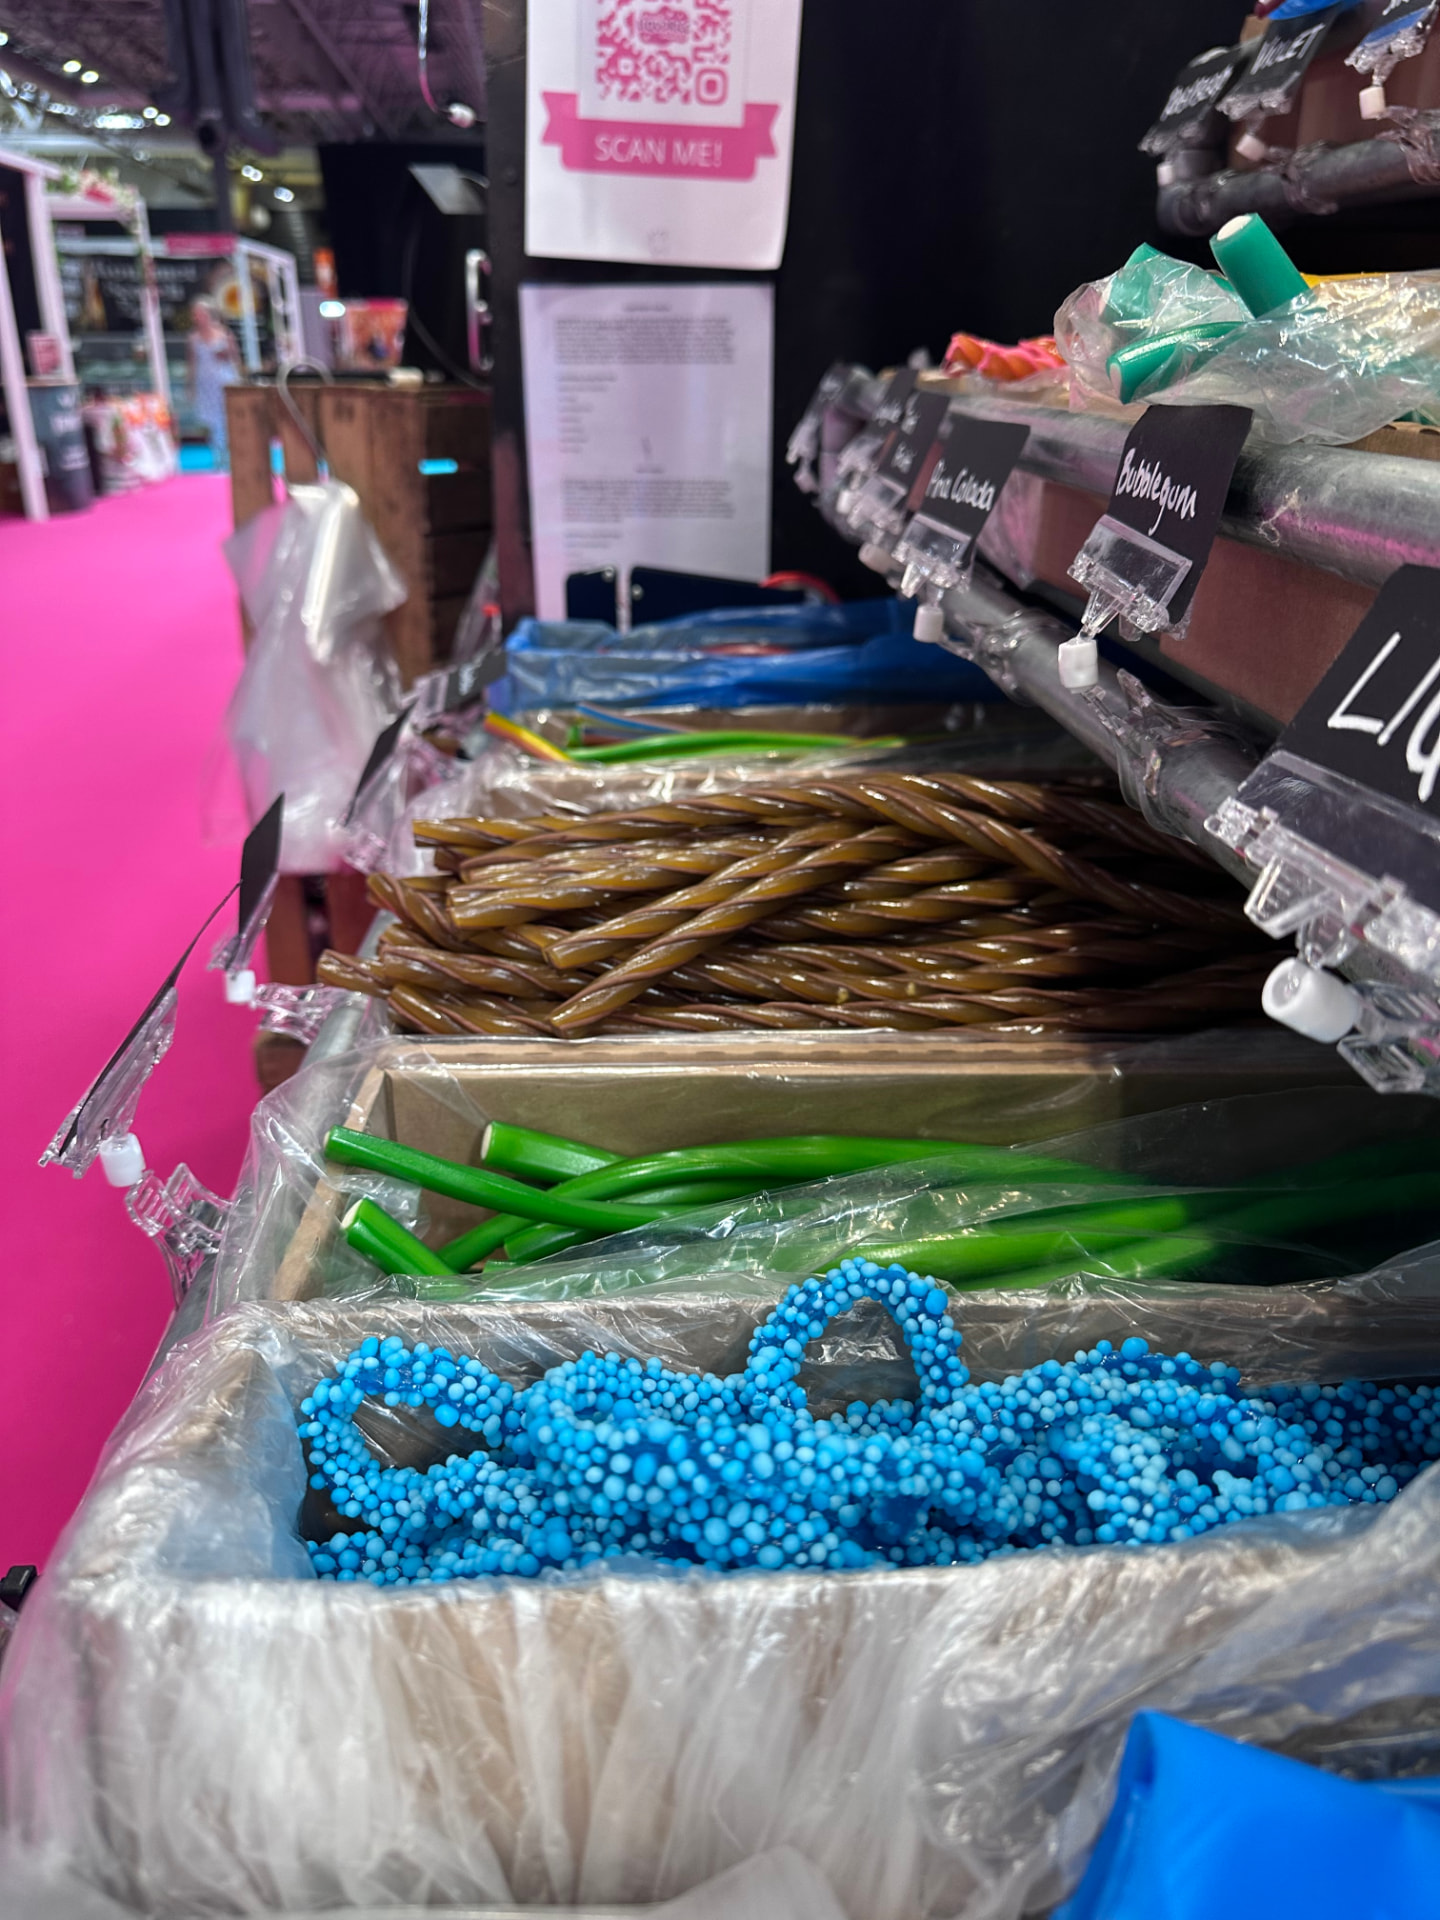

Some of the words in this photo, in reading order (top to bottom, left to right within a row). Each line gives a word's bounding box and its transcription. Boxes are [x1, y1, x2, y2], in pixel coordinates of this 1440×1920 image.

[595, 134, 667, 165] SCAN
[672, 139, 722, 167] ME!
[951, 466, 995, 511] Colada
[1115, 447, 1197, 536] Bubblegum
